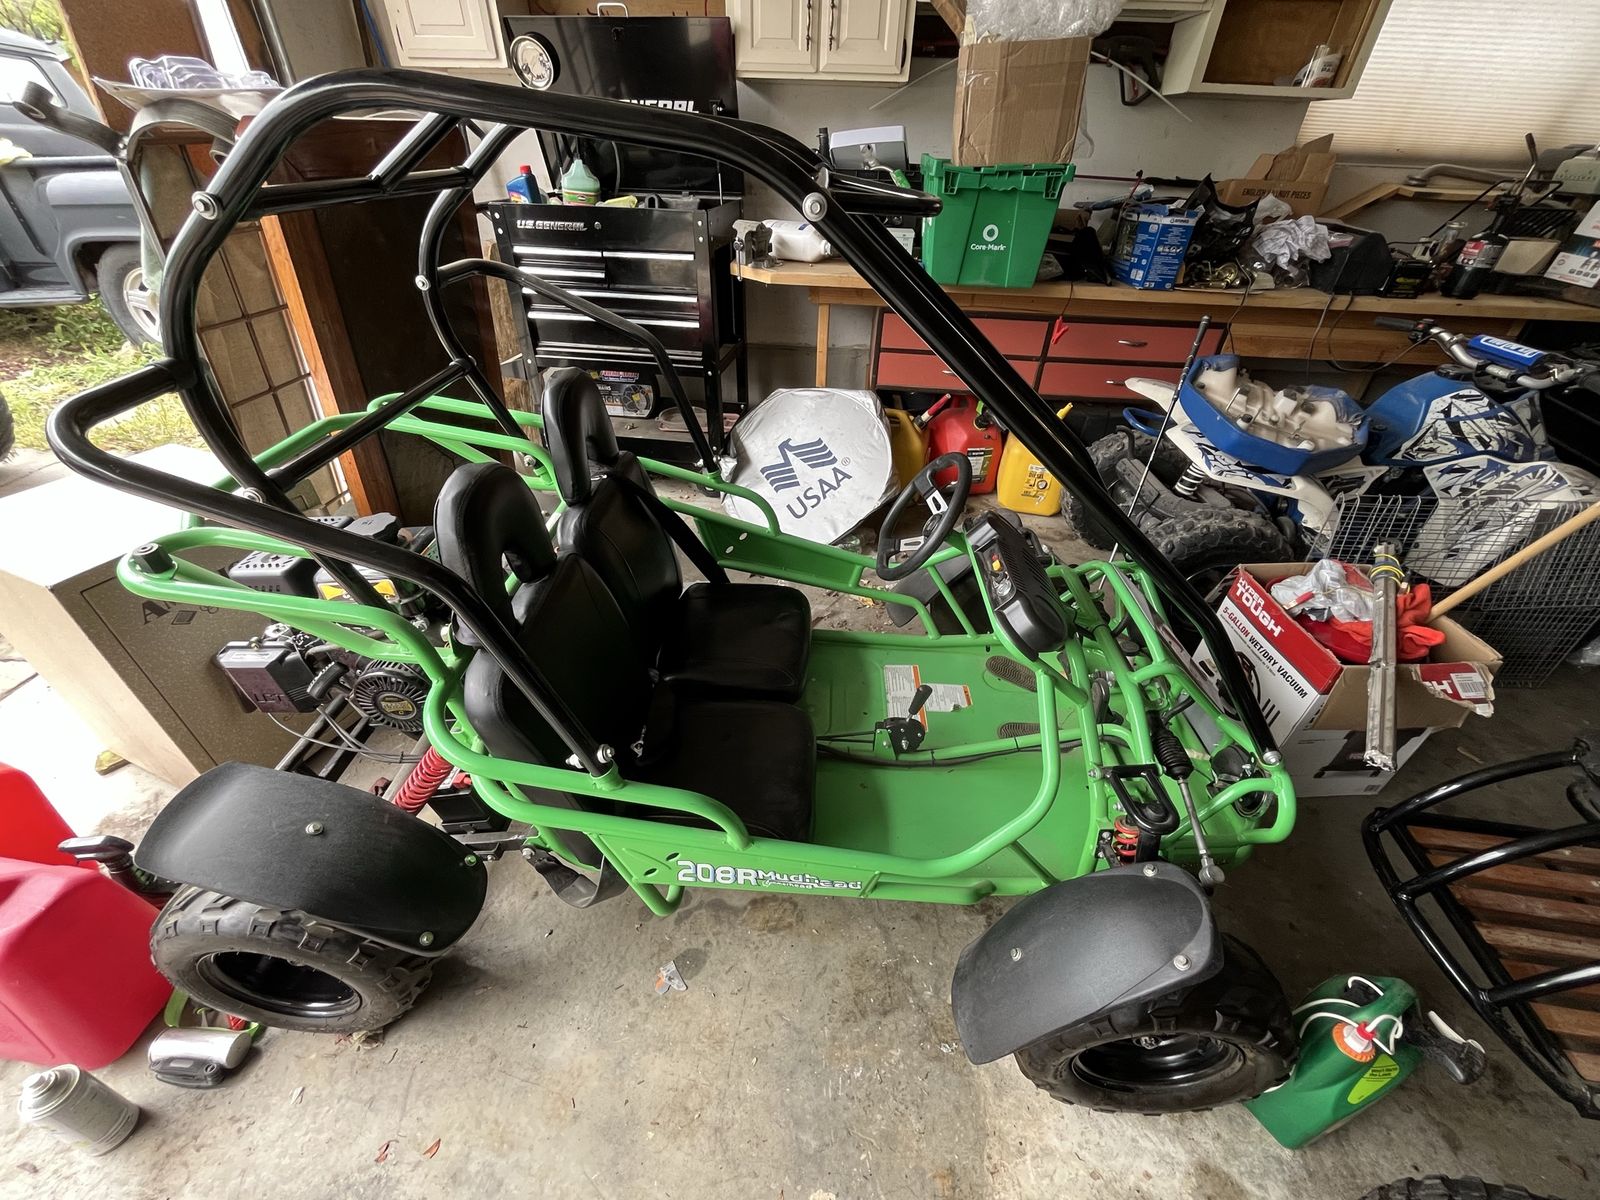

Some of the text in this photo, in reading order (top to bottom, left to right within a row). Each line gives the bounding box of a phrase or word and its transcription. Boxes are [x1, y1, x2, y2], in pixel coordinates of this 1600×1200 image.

[618, 98, 699, 114] ERAL
[1242, 188, 1267, 197] ENGLISH
[1291, 191, 1312, 199] PIECES
[535, 220, 588, 231] GENERAL
[786, 466, 853, 519] USAA
[1238, 576, 1266, 608] HYPER
[1236, 581, 1284, 638] TOUGH
[1222, 605, 1251, 638] 5-GALLON
[1248, 634, 1279, 667] WET/DRY
[1276, 664, 1309, 700] VACUUM
[676, 860, 759, 886] 208R
[756, 869, 863, 891] Mudhead
